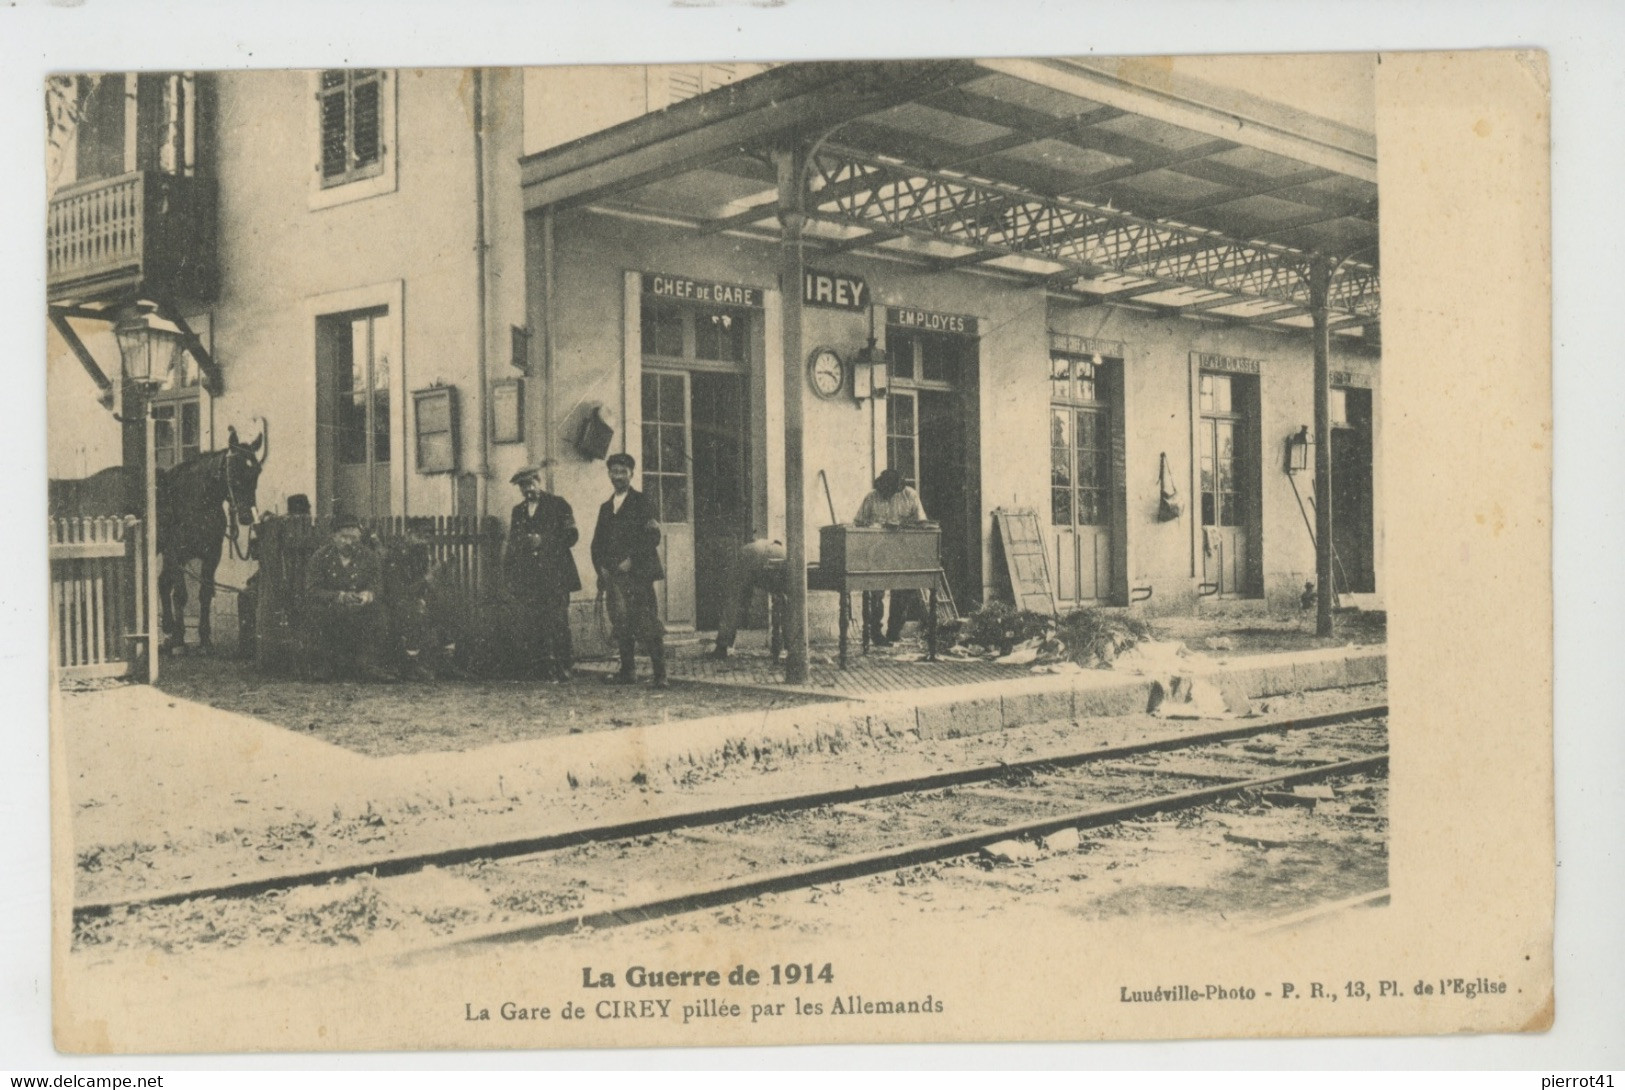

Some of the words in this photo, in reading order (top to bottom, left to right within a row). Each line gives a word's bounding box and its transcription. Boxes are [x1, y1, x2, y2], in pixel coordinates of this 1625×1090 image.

[653, 277, 694, 297] CHEF
[697, 286, 710, 300] DE
[714, 284, 753, 305] GARE
[805, 274, 864, 306] IREY
[899, 310, 965, 332] EMPLOYES
